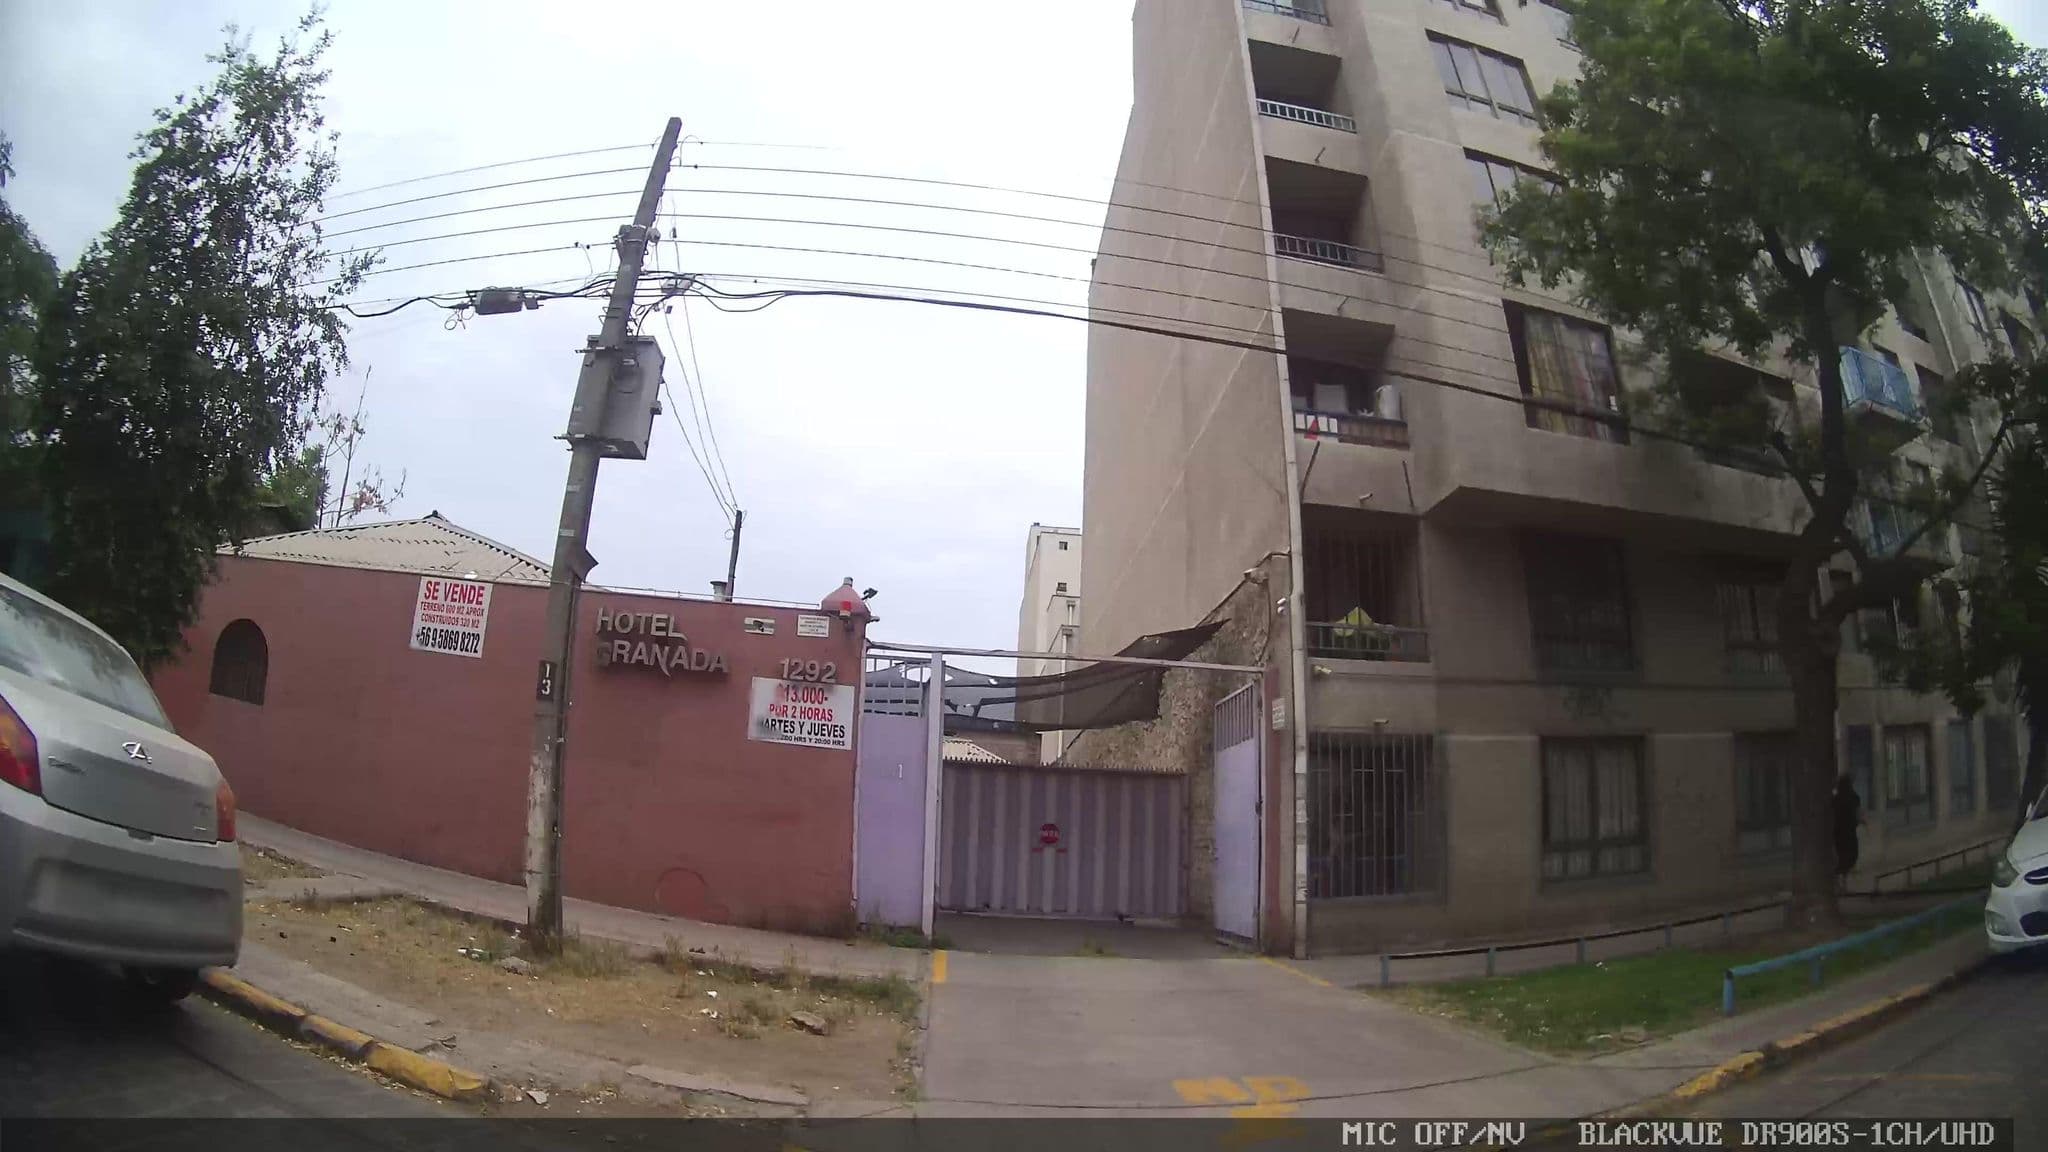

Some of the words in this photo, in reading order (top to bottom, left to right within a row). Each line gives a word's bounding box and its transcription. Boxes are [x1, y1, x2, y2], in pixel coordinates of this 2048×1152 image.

[424, 580, 440, 601] SE
[444, 582, 485, 605] VENDE
[420, 602, 445, 613] TERRENO
[421, 613, 459, 626] CONSTRUIDOS
[596, 607, 688, 641] HOTEL
[431, 628, 438, 648] 9
[438, 629, 460, 652] 5869
[460, 631, 480, 654] 8272
[780, 658, 837, 683] 1292
[769, 703, 788, 719] POR
[791, 705, 798, 719] 2
[800, 706, 833, 722] HORAS
[798, 720, 806, 735] Y
[807, 721, 846, 739] JUEVES
[794, 735, 807, 744] HRS
[814, 737, 832, 745] 20:00
[832, 738, 846, 747] HRS
